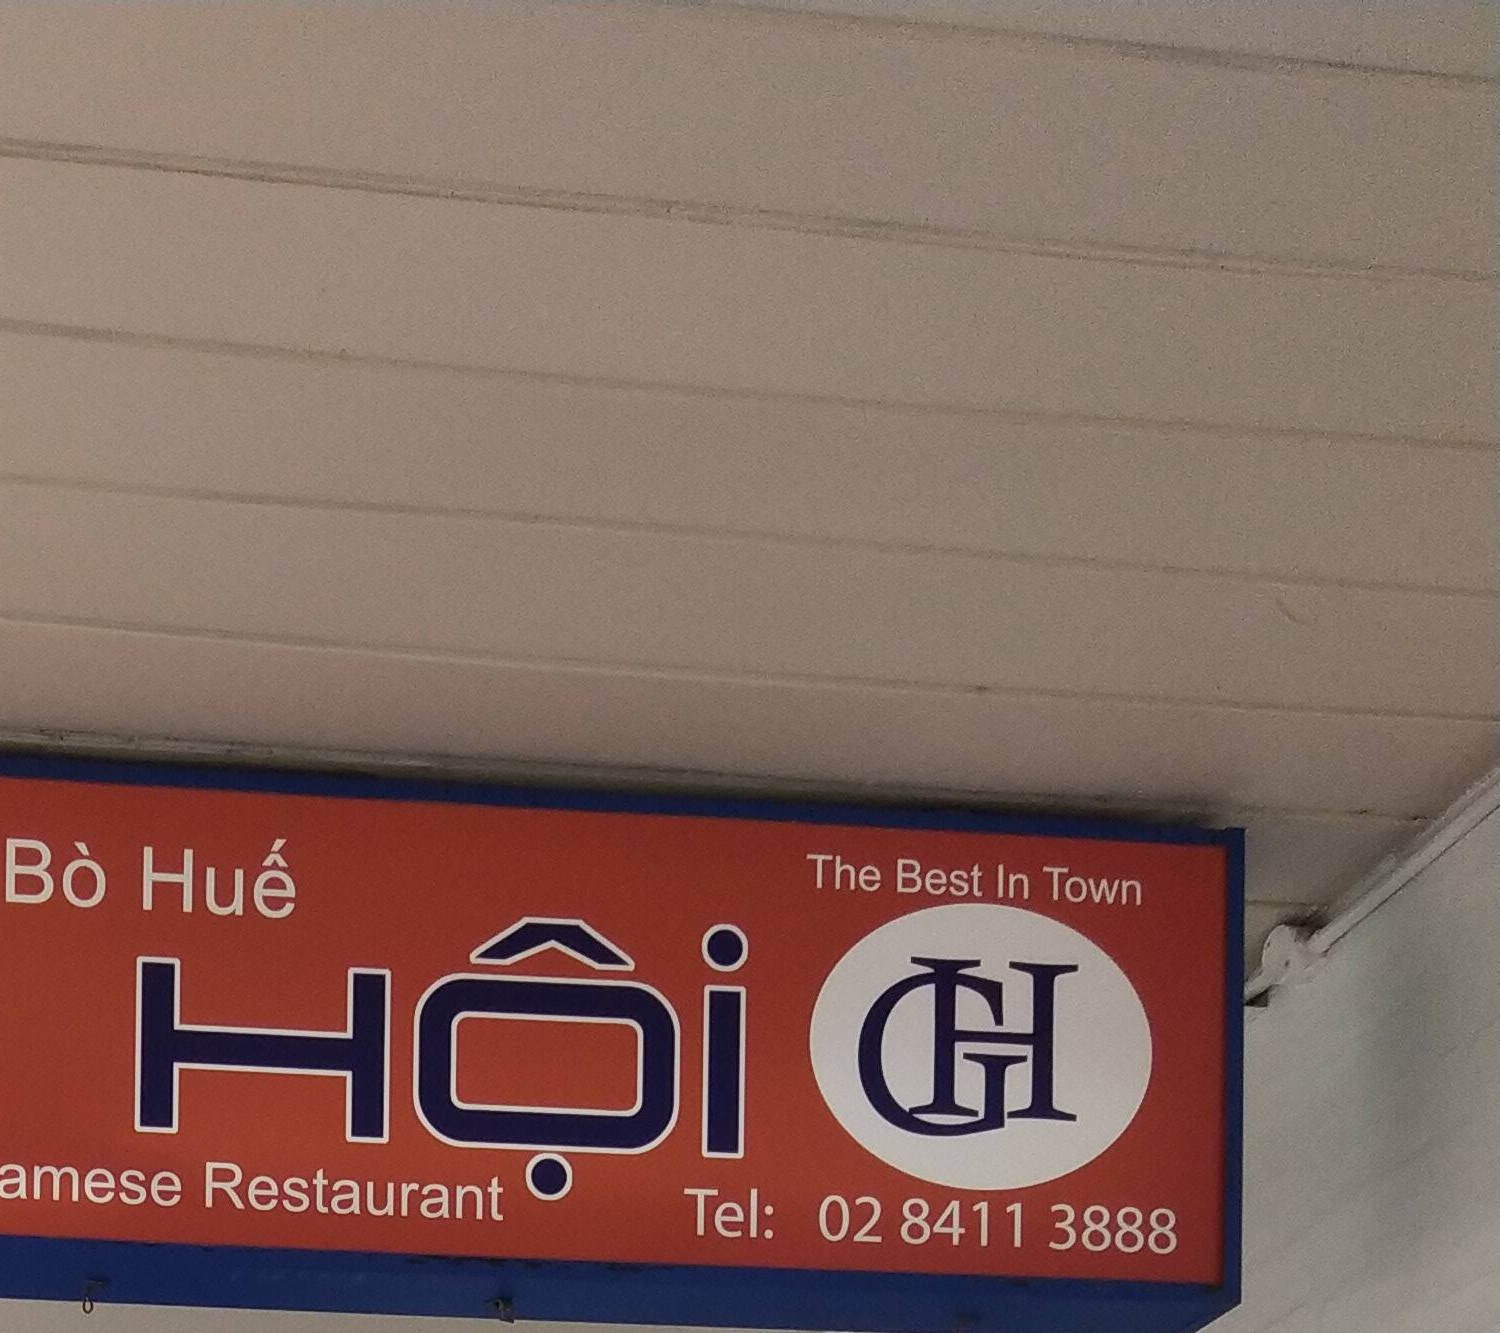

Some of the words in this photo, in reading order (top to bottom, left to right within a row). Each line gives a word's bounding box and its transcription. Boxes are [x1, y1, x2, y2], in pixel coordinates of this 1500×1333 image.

[4, 838, 108, 909] Bò
[141, 837, 298, 922] Huế
[807, 853, 883, 894] The
[896, 858, 984, 900] Best
[995, 863, 1031, 902] In
[1043, 866, 1144, 907] Town
[204, 1161, 505, 1222] Restaurant
[684, 1186, 778, 1241] Tel:
[818, 1194, 885, 1247] 02
[899, 1196, 1029, 1251] 8411
[1048, 1200, 1180, 1257] 3888
